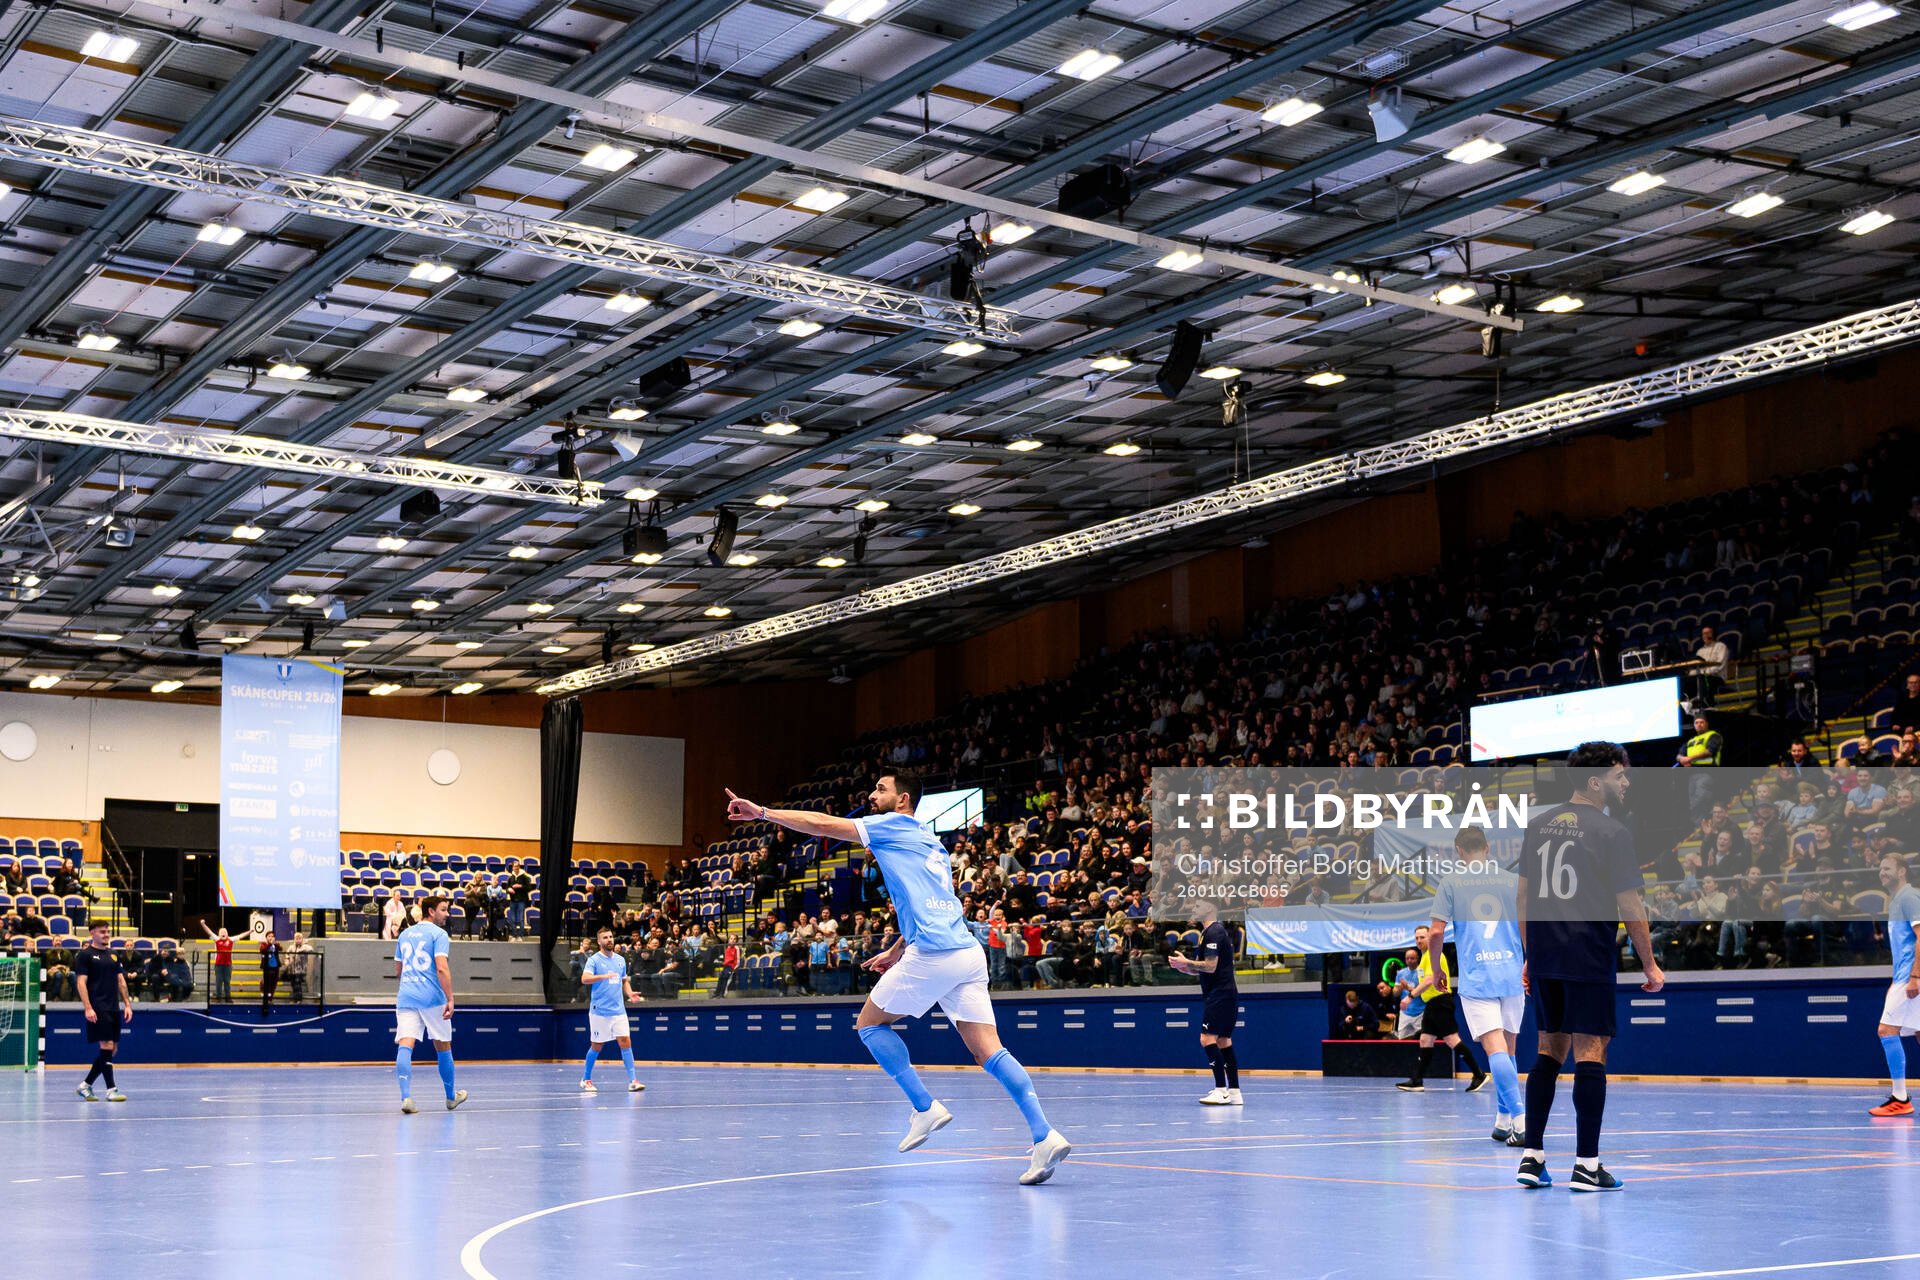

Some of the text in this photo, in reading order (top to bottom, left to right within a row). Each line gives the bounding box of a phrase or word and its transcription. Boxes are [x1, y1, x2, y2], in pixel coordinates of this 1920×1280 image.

[230, 684, 337, 705] SKÅNECUPEN 25/26
[1537, 840, 1578, 899] 16
[926, 896, 954, 911] akea
[1471, 894, 1503, 939] 9
[400, 941, 432, 972] 26
[1475, 950, 1502, 962] akea
